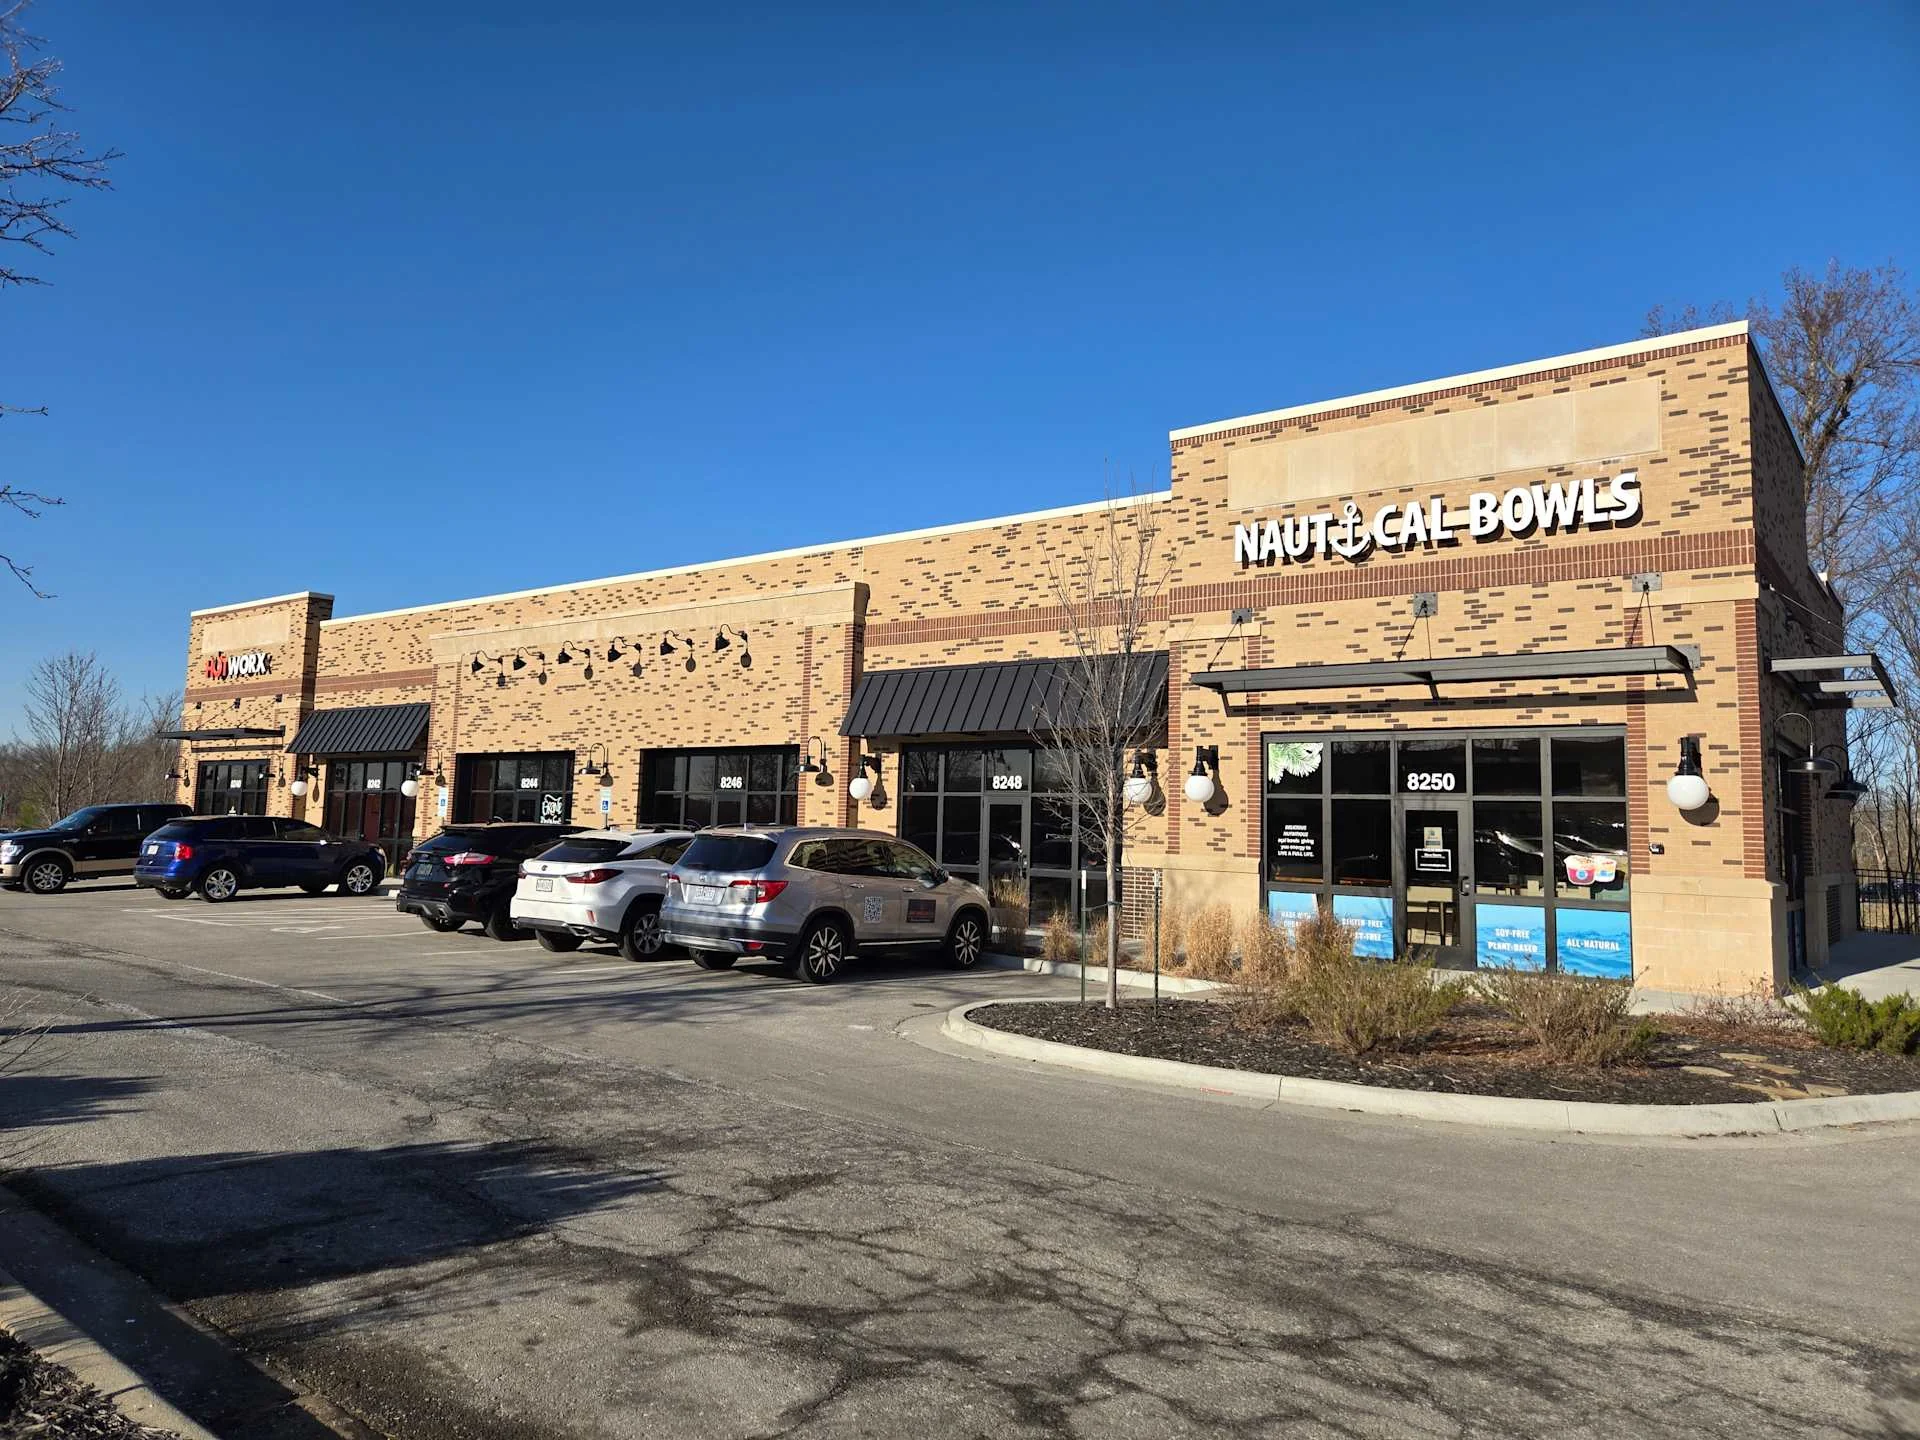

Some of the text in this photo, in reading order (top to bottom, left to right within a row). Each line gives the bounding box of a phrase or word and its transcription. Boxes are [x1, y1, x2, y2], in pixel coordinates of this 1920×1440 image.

[1468, 472, 1641, 537] BOWLS
[521, 777, 538, 789] 8244
[720, 776, 742, 789] 8246
[992, 775, 1022, 790] 8248
[1407, 772, 1455, 791] 8250
[1495, 928, 1530, 939] SOY-FREE
[1487, 941, 1538, 953] PLANT-BASED
[1566, 938, 1620, 951] ALL-NATURAL
